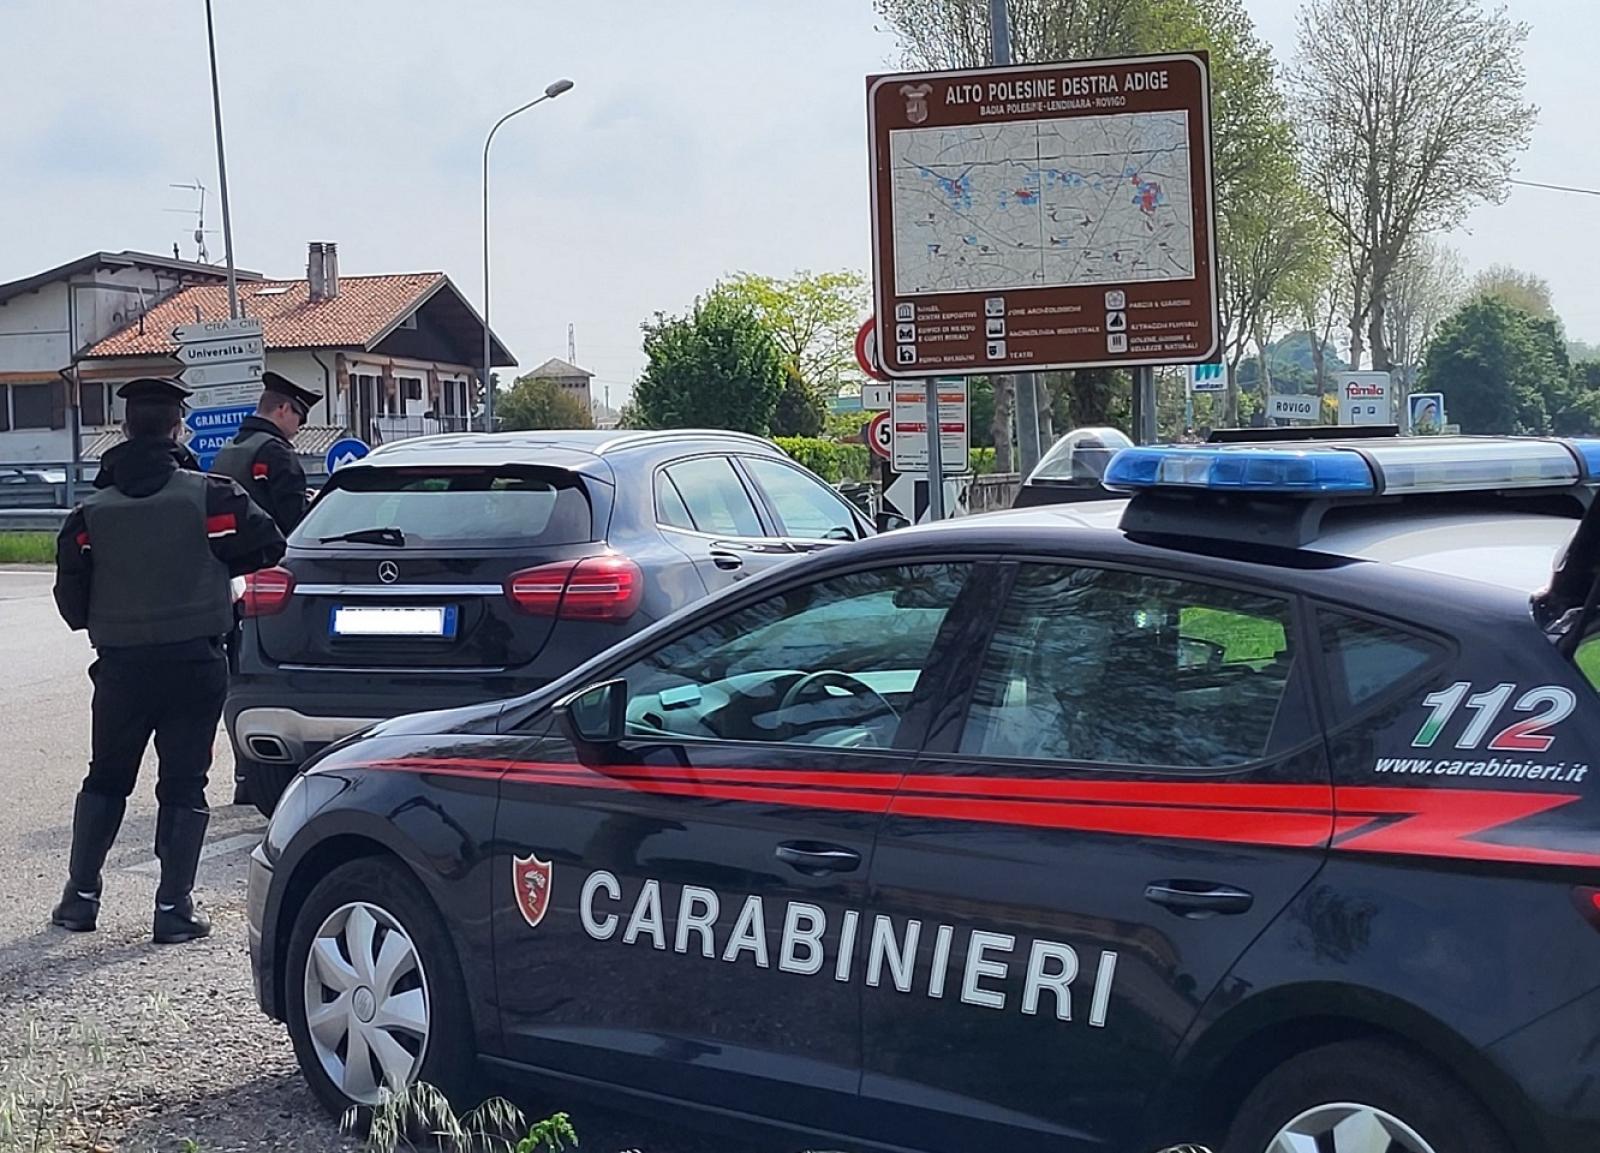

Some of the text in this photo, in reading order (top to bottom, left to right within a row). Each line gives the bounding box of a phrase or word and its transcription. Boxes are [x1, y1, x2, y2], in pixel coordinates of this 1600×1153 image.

[946, 71, 1169, 104] ALTO POLESINE DESTRA ADIGE
[980, 105, 1005, 115] BADIA
[1345, 381, 1384, 400] famila
[1276, 401, 1311, 413] ROVIGO
[880, 424, 891, 444] 5
[1411, 681, 1577, 752] 112
[1374, 757, 1589, 783] www.carabinieri.it
[579, 869, 1118, 1028] CARABINIERI
